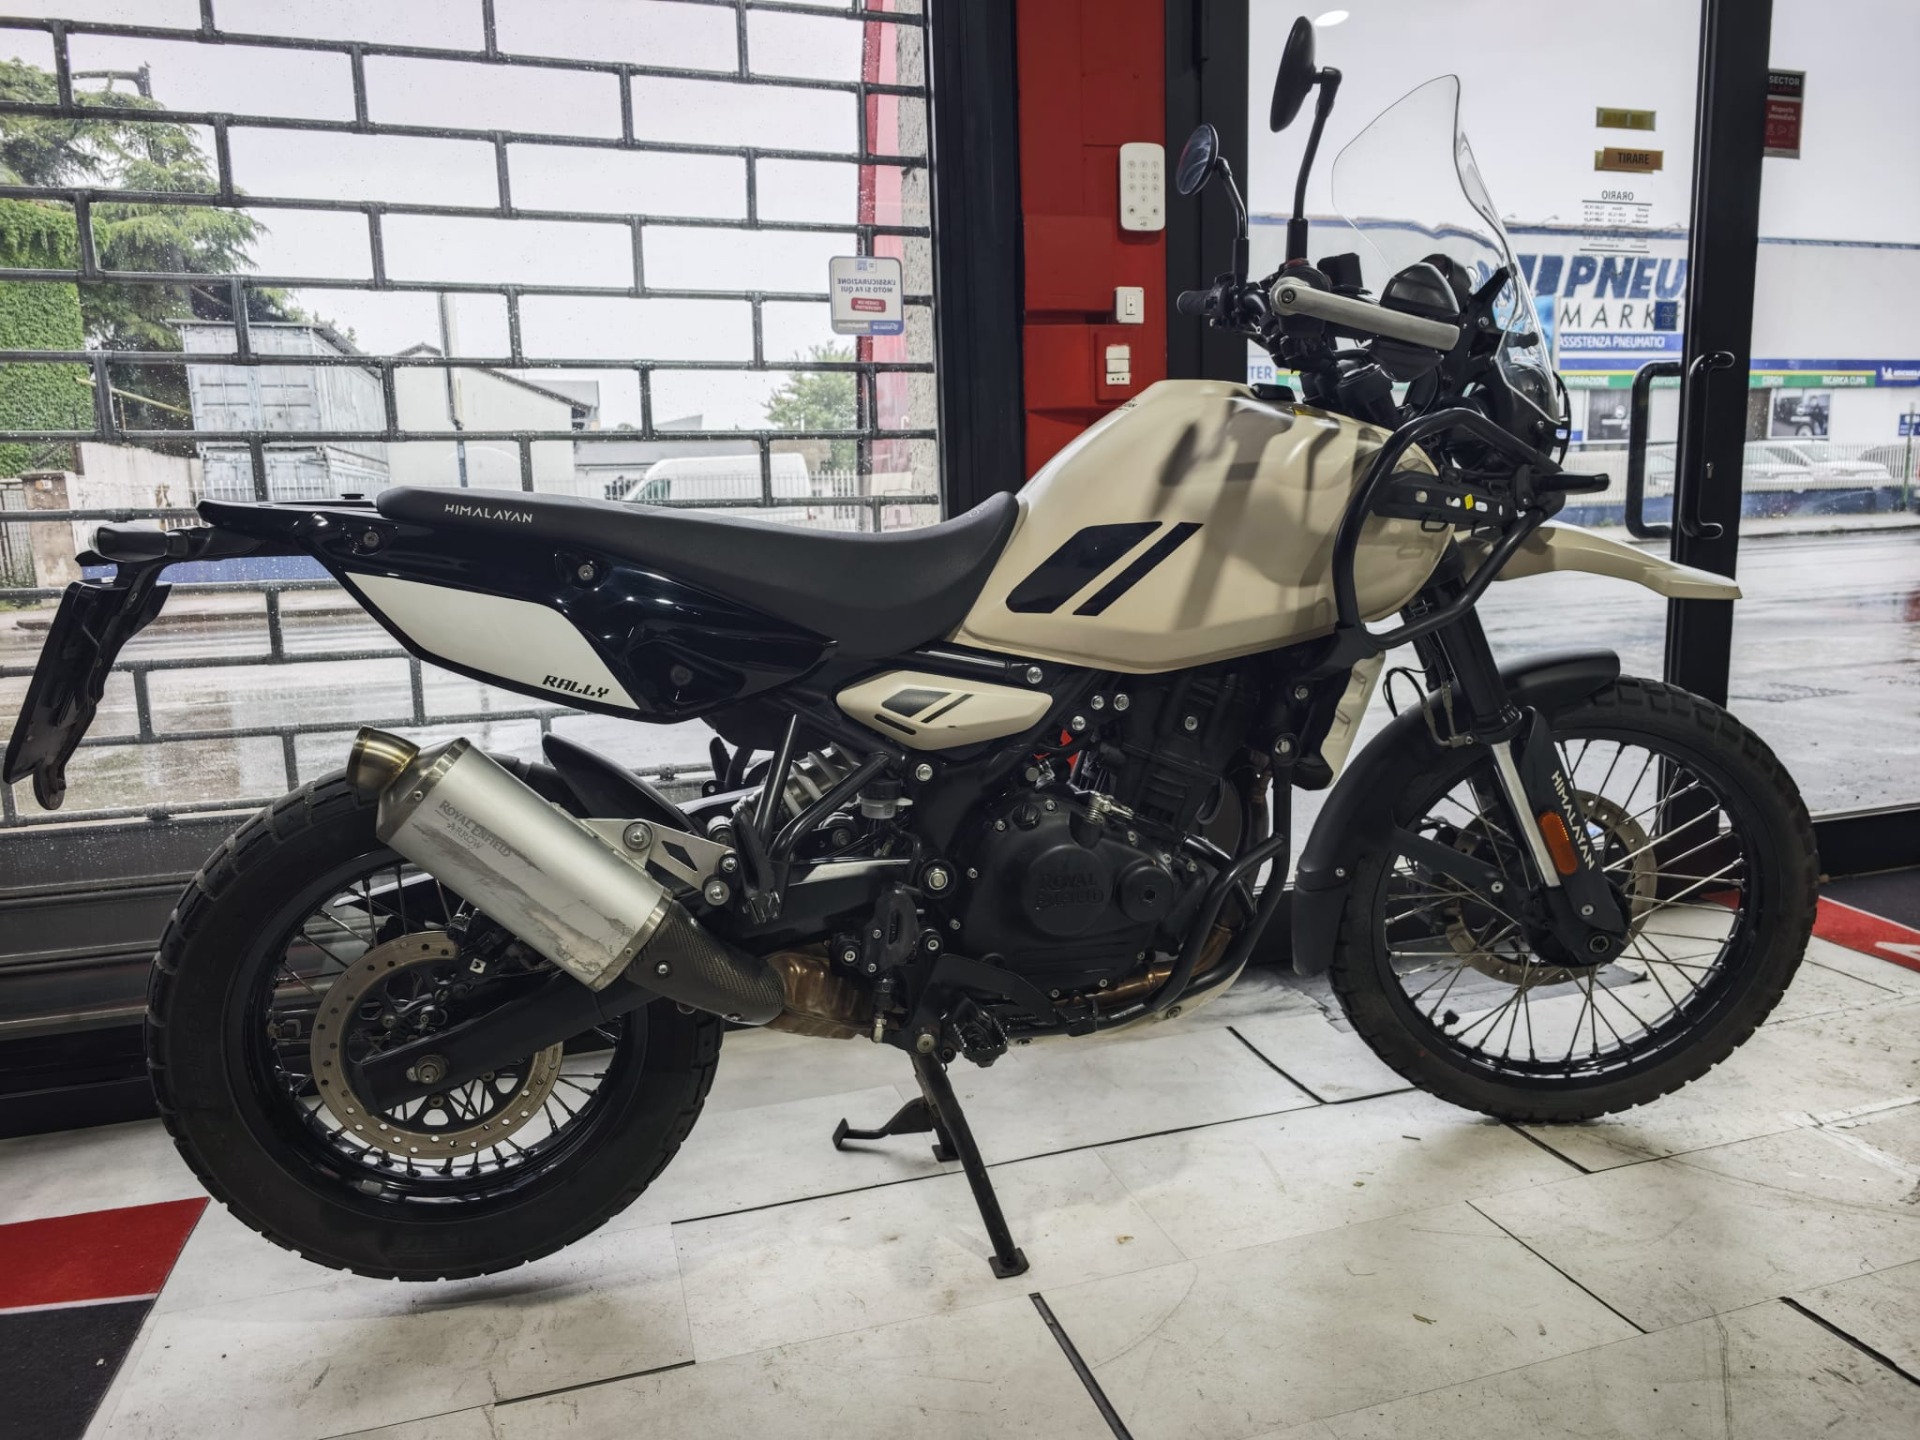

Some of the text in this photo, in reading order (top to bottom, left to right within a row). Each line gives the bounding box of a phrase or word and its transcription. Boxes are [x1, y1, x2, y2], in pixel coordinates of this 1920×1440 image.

[1769, 75, 1800, 86] SECTOR
[1617, 152, 1650, 165] TIRARE
[1562, 255, 1687, 299] PNEU
[1560, 303, 1682, 328] MARK
[1560, 336, 1665, 348] ASSISTENZA PNEUMATICI
[444, 503, 533, 523] HIMALAYAN
[542, 675, 610, 698] RALLY
[439, 800, 512, 857] ROYAL ENFIELD
[1551, 769, 1595, 871] HIMALAYAN
